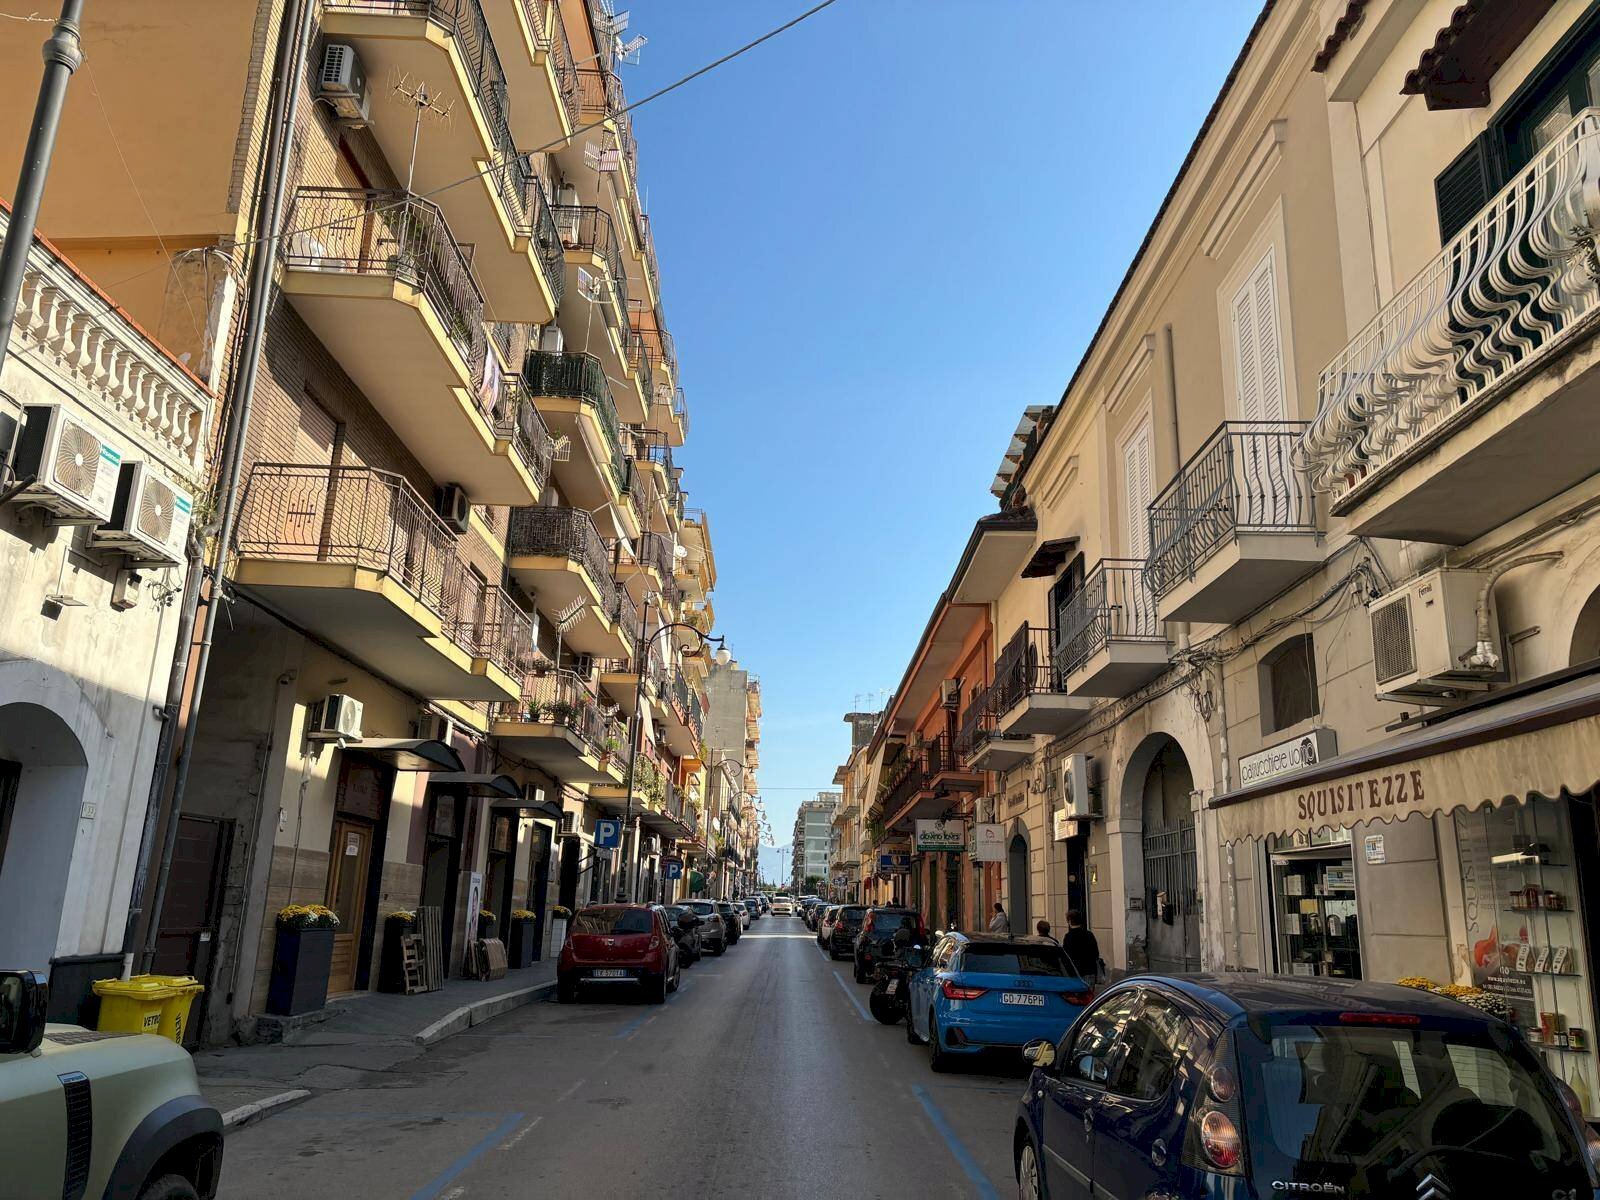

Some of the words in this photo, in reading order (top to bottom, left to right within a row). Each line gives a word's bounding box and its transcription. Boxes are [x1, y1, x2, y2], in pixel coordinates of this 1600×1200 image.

[1298, 769, 1425, 822] SQUISITEZZE
[599, 822, 615, 845] P
[669, 864, 679, 878] P
[1271, 1180, 1345, 1193] CITROËN
